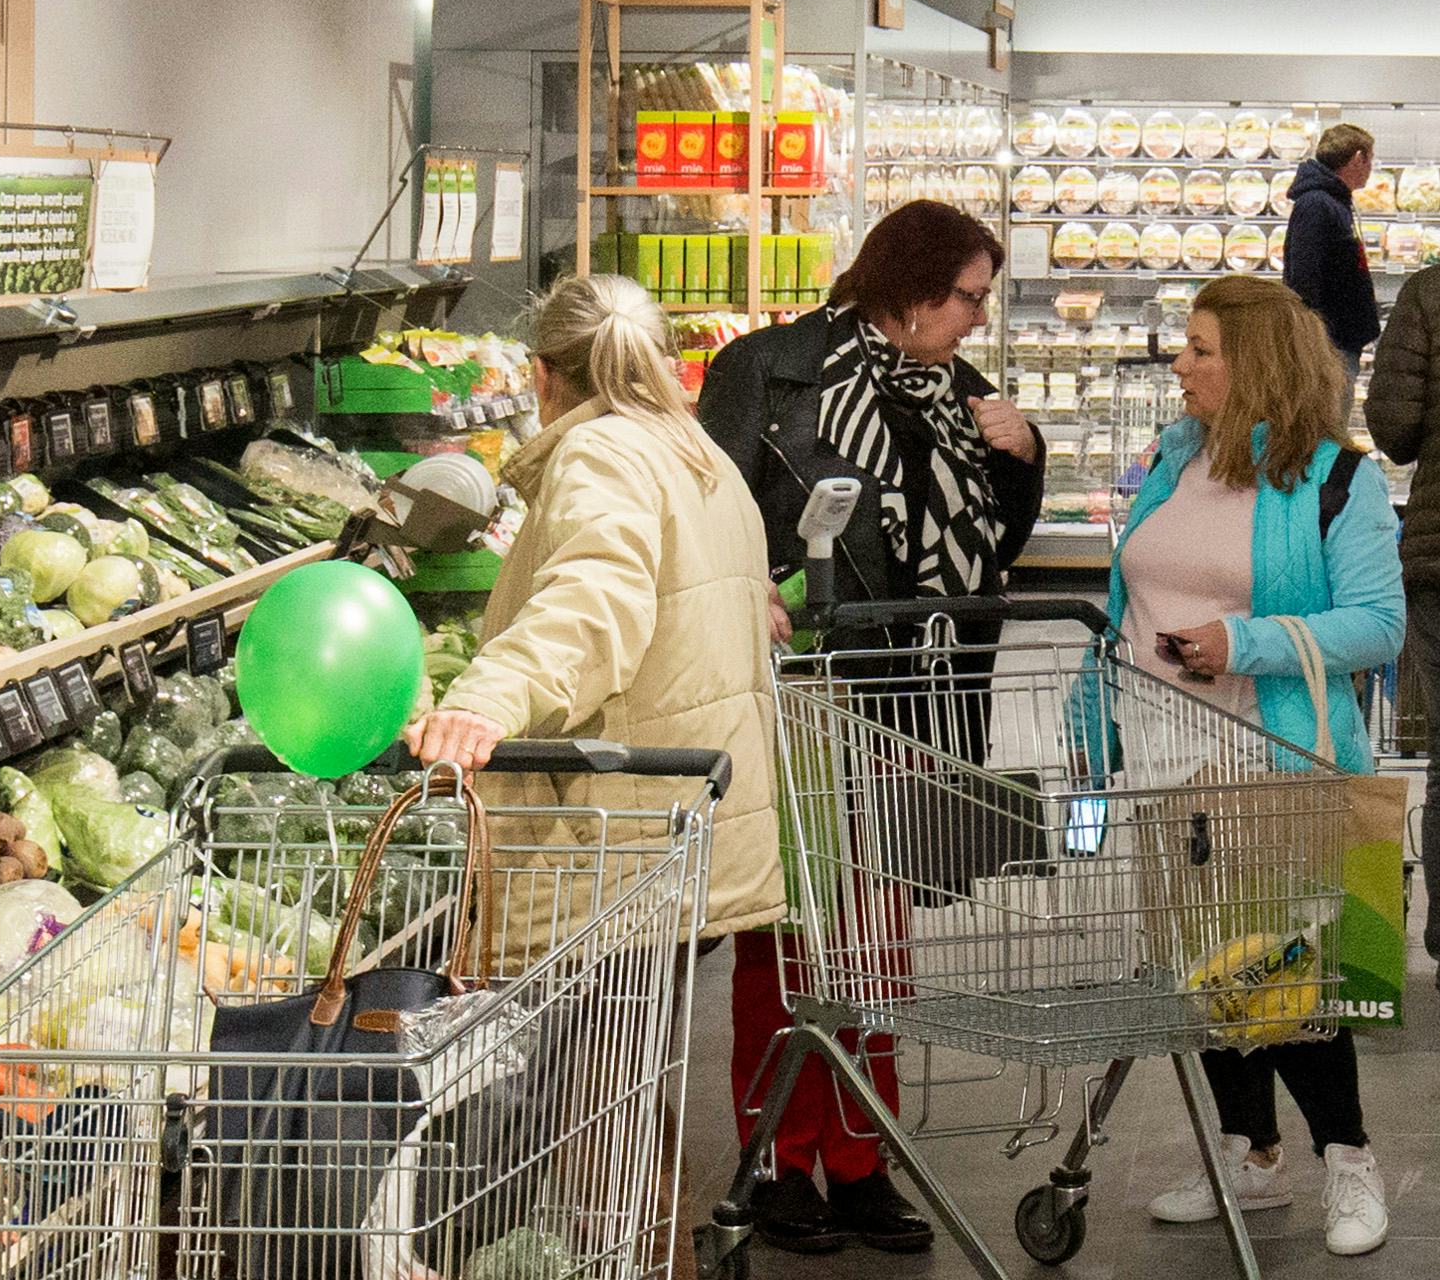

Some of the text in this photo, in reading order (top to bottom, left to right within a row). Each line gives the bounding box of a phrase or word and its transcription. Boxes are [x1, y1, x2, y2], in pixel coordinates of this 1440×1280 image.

[644, 163, 666, 174] mie
[681, 163, 704, 174] mie
[781, 164, 803, 174] mie
